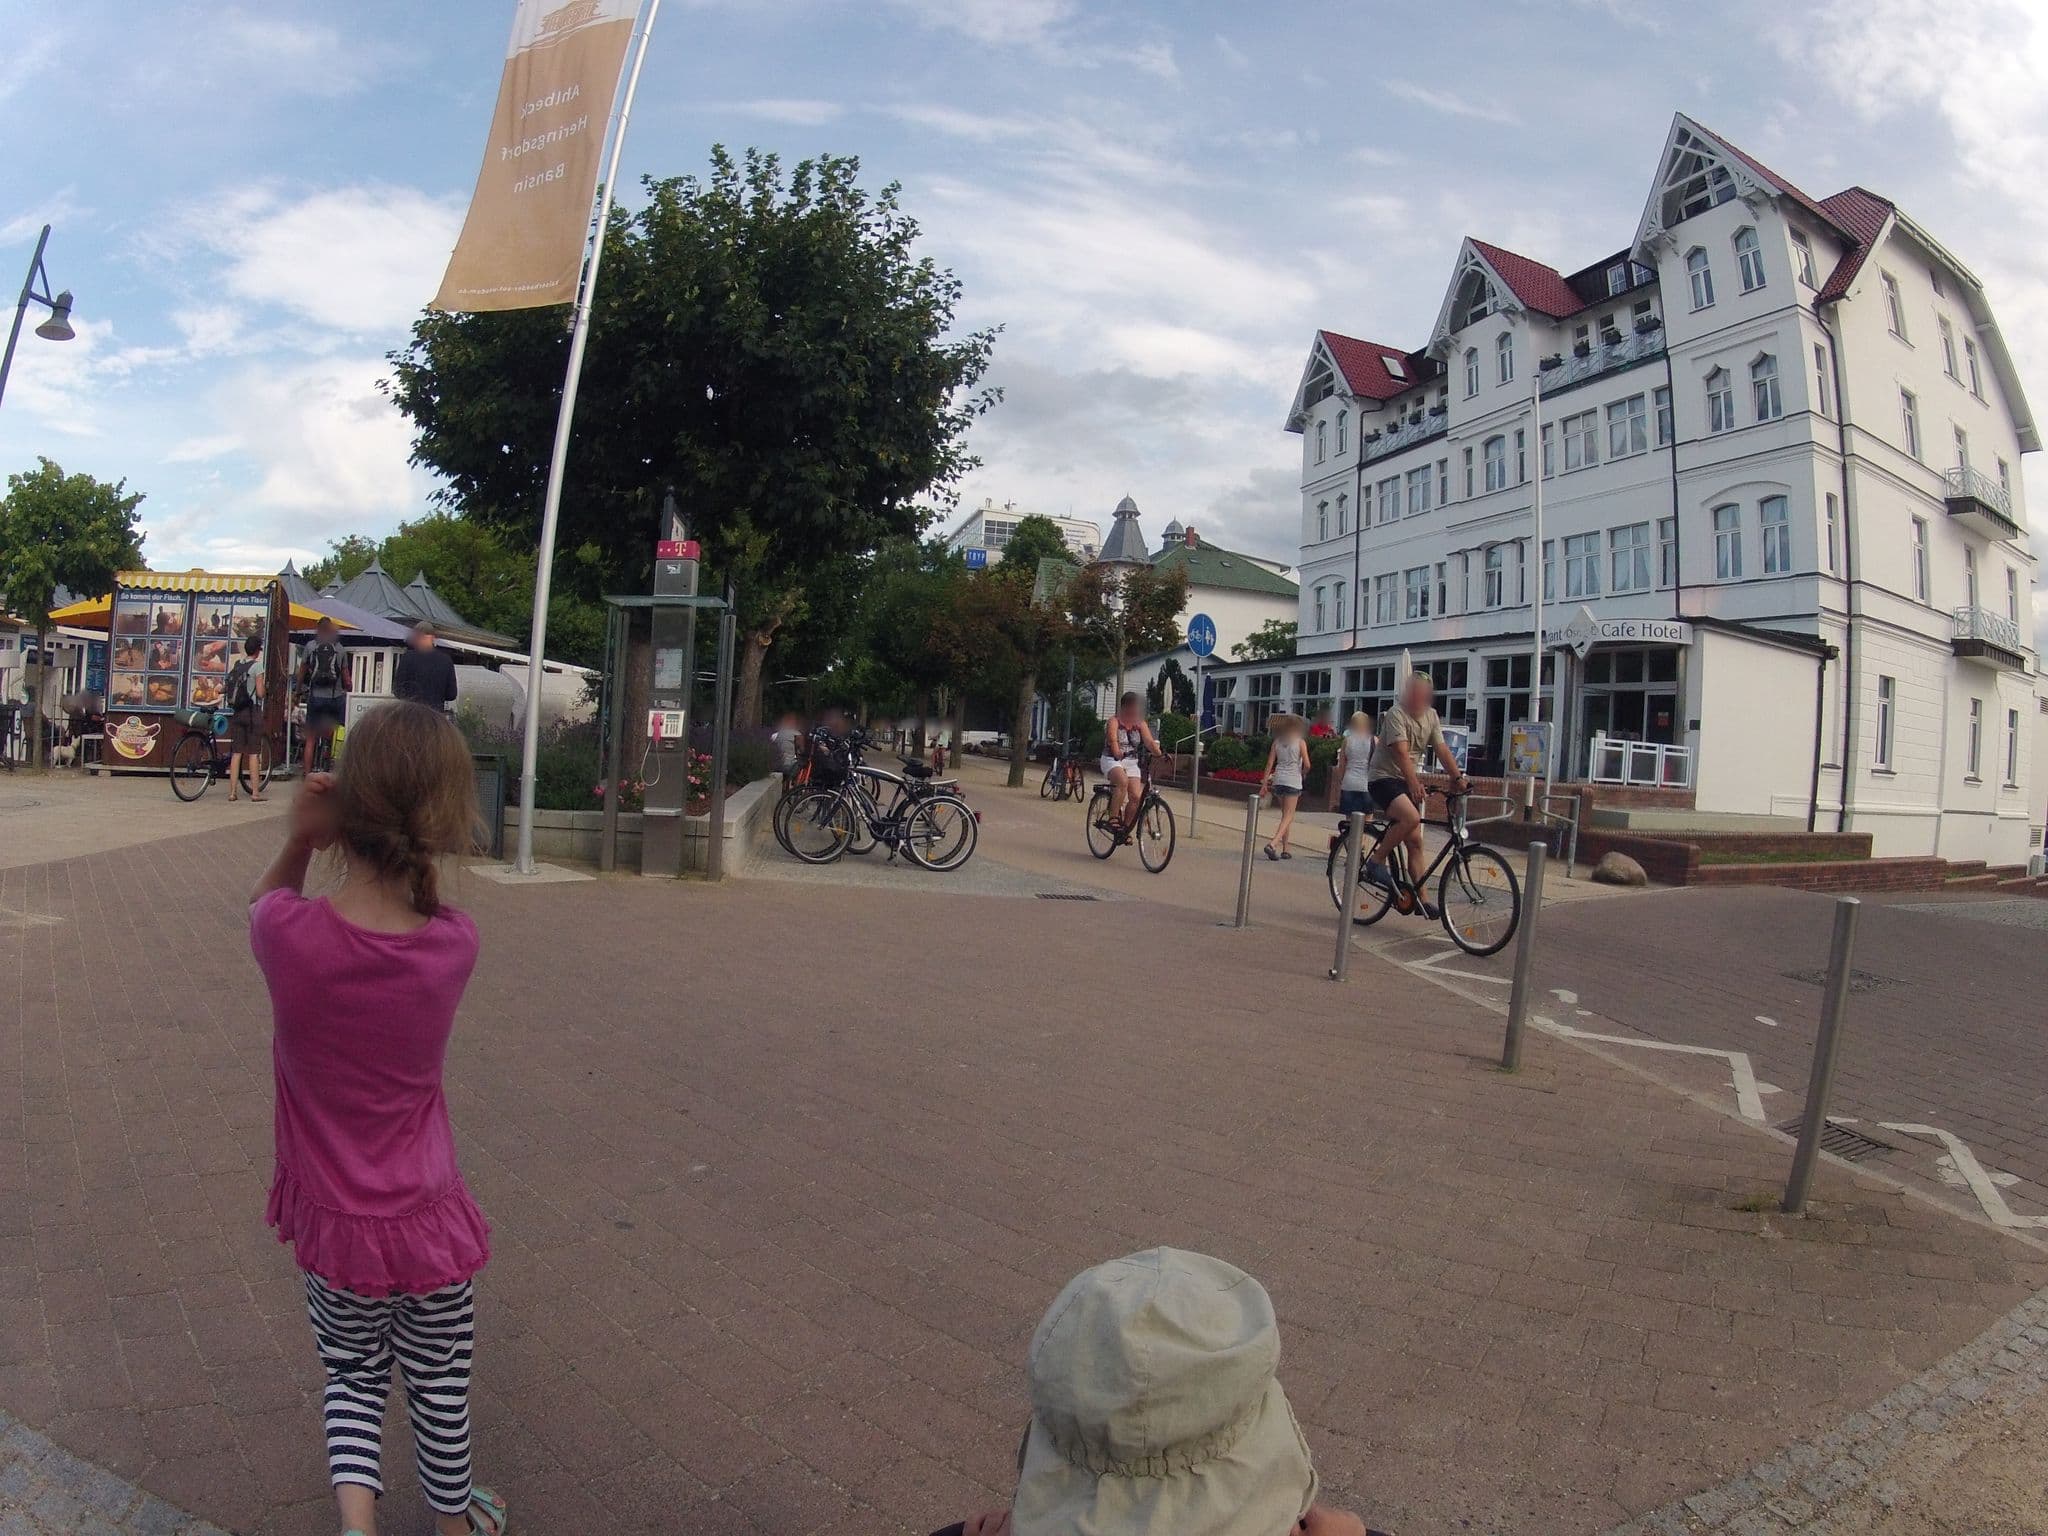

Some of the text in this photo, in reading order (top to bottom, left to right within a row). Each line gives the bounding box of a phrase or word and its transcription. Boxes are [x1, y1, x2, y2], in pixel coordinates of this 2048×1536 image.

[250, 596, 268, 604] Tisch
[1601, 622, 1635, 638] Cafe
[1642, 623, 1682, 640] Hotel
